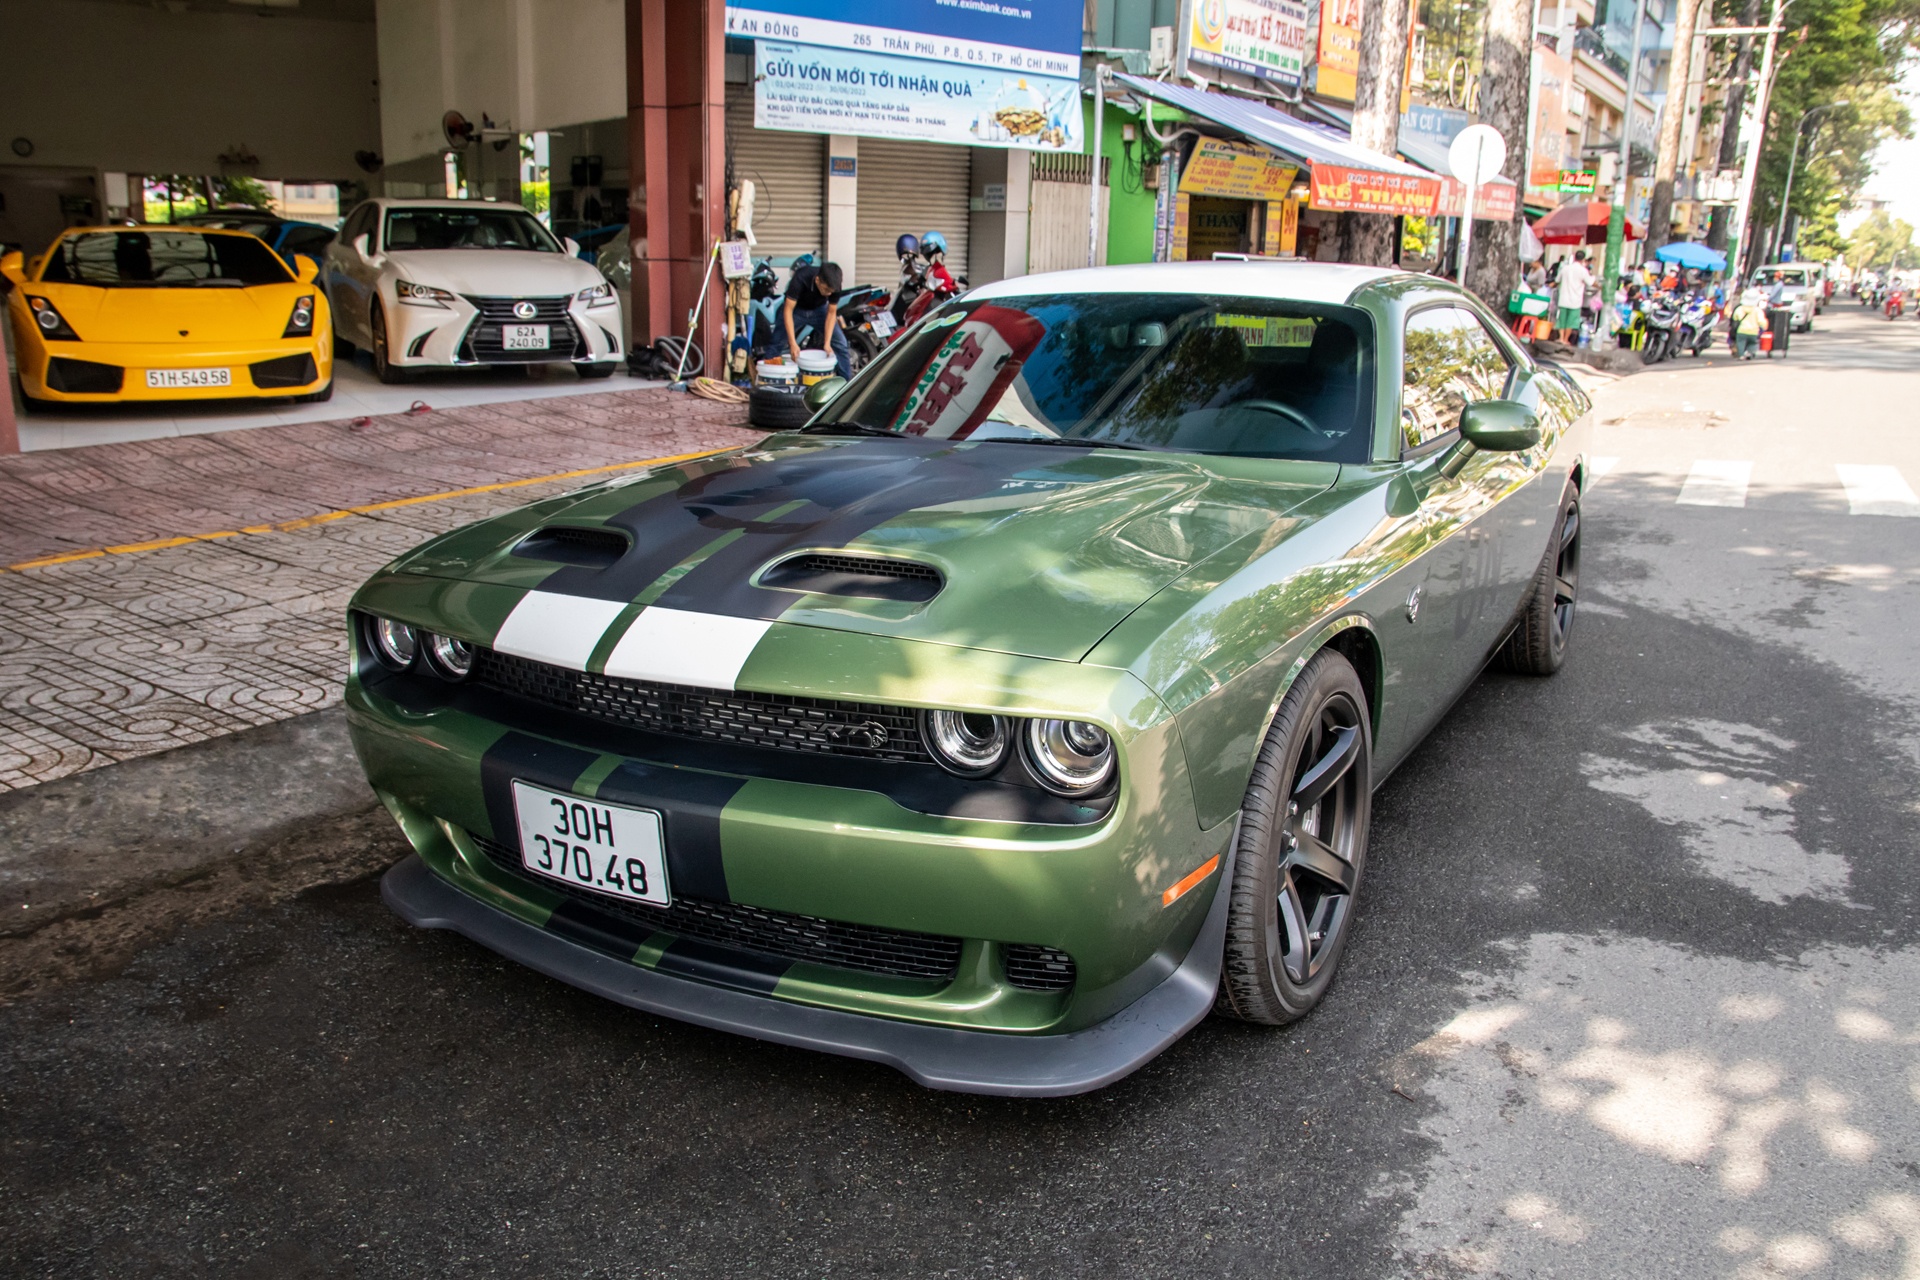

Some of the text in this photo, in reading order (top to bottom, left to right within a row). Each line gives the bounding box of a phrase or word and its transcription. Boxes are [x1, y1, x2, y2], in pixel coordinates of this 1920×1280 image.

[741, 20, 758, 32] AN
[764, 21, 799, 38] ĐÔNG
[853, 33, 872, 46] 265
[1010, 53, 1022, 66] HỒ
[1027, 57, 1042, 69] CHÍ
[1046, 60, 1068, 72] MINH
[766, 58, 972, 98] GỬI VỐN MỚI TỚI NHẬN QUÀ
[1319, 182, 1352, 201] KẾ
[516, 327, 536, 337] 62A
[510, 338, 544, 348] 240.09
[149, 370, 228, 385] 51H-549.58
[794, 720, 868, 738] SRT
[551, 798, 615, 847] 30H
[534, 834, 649, 895] 370.48
